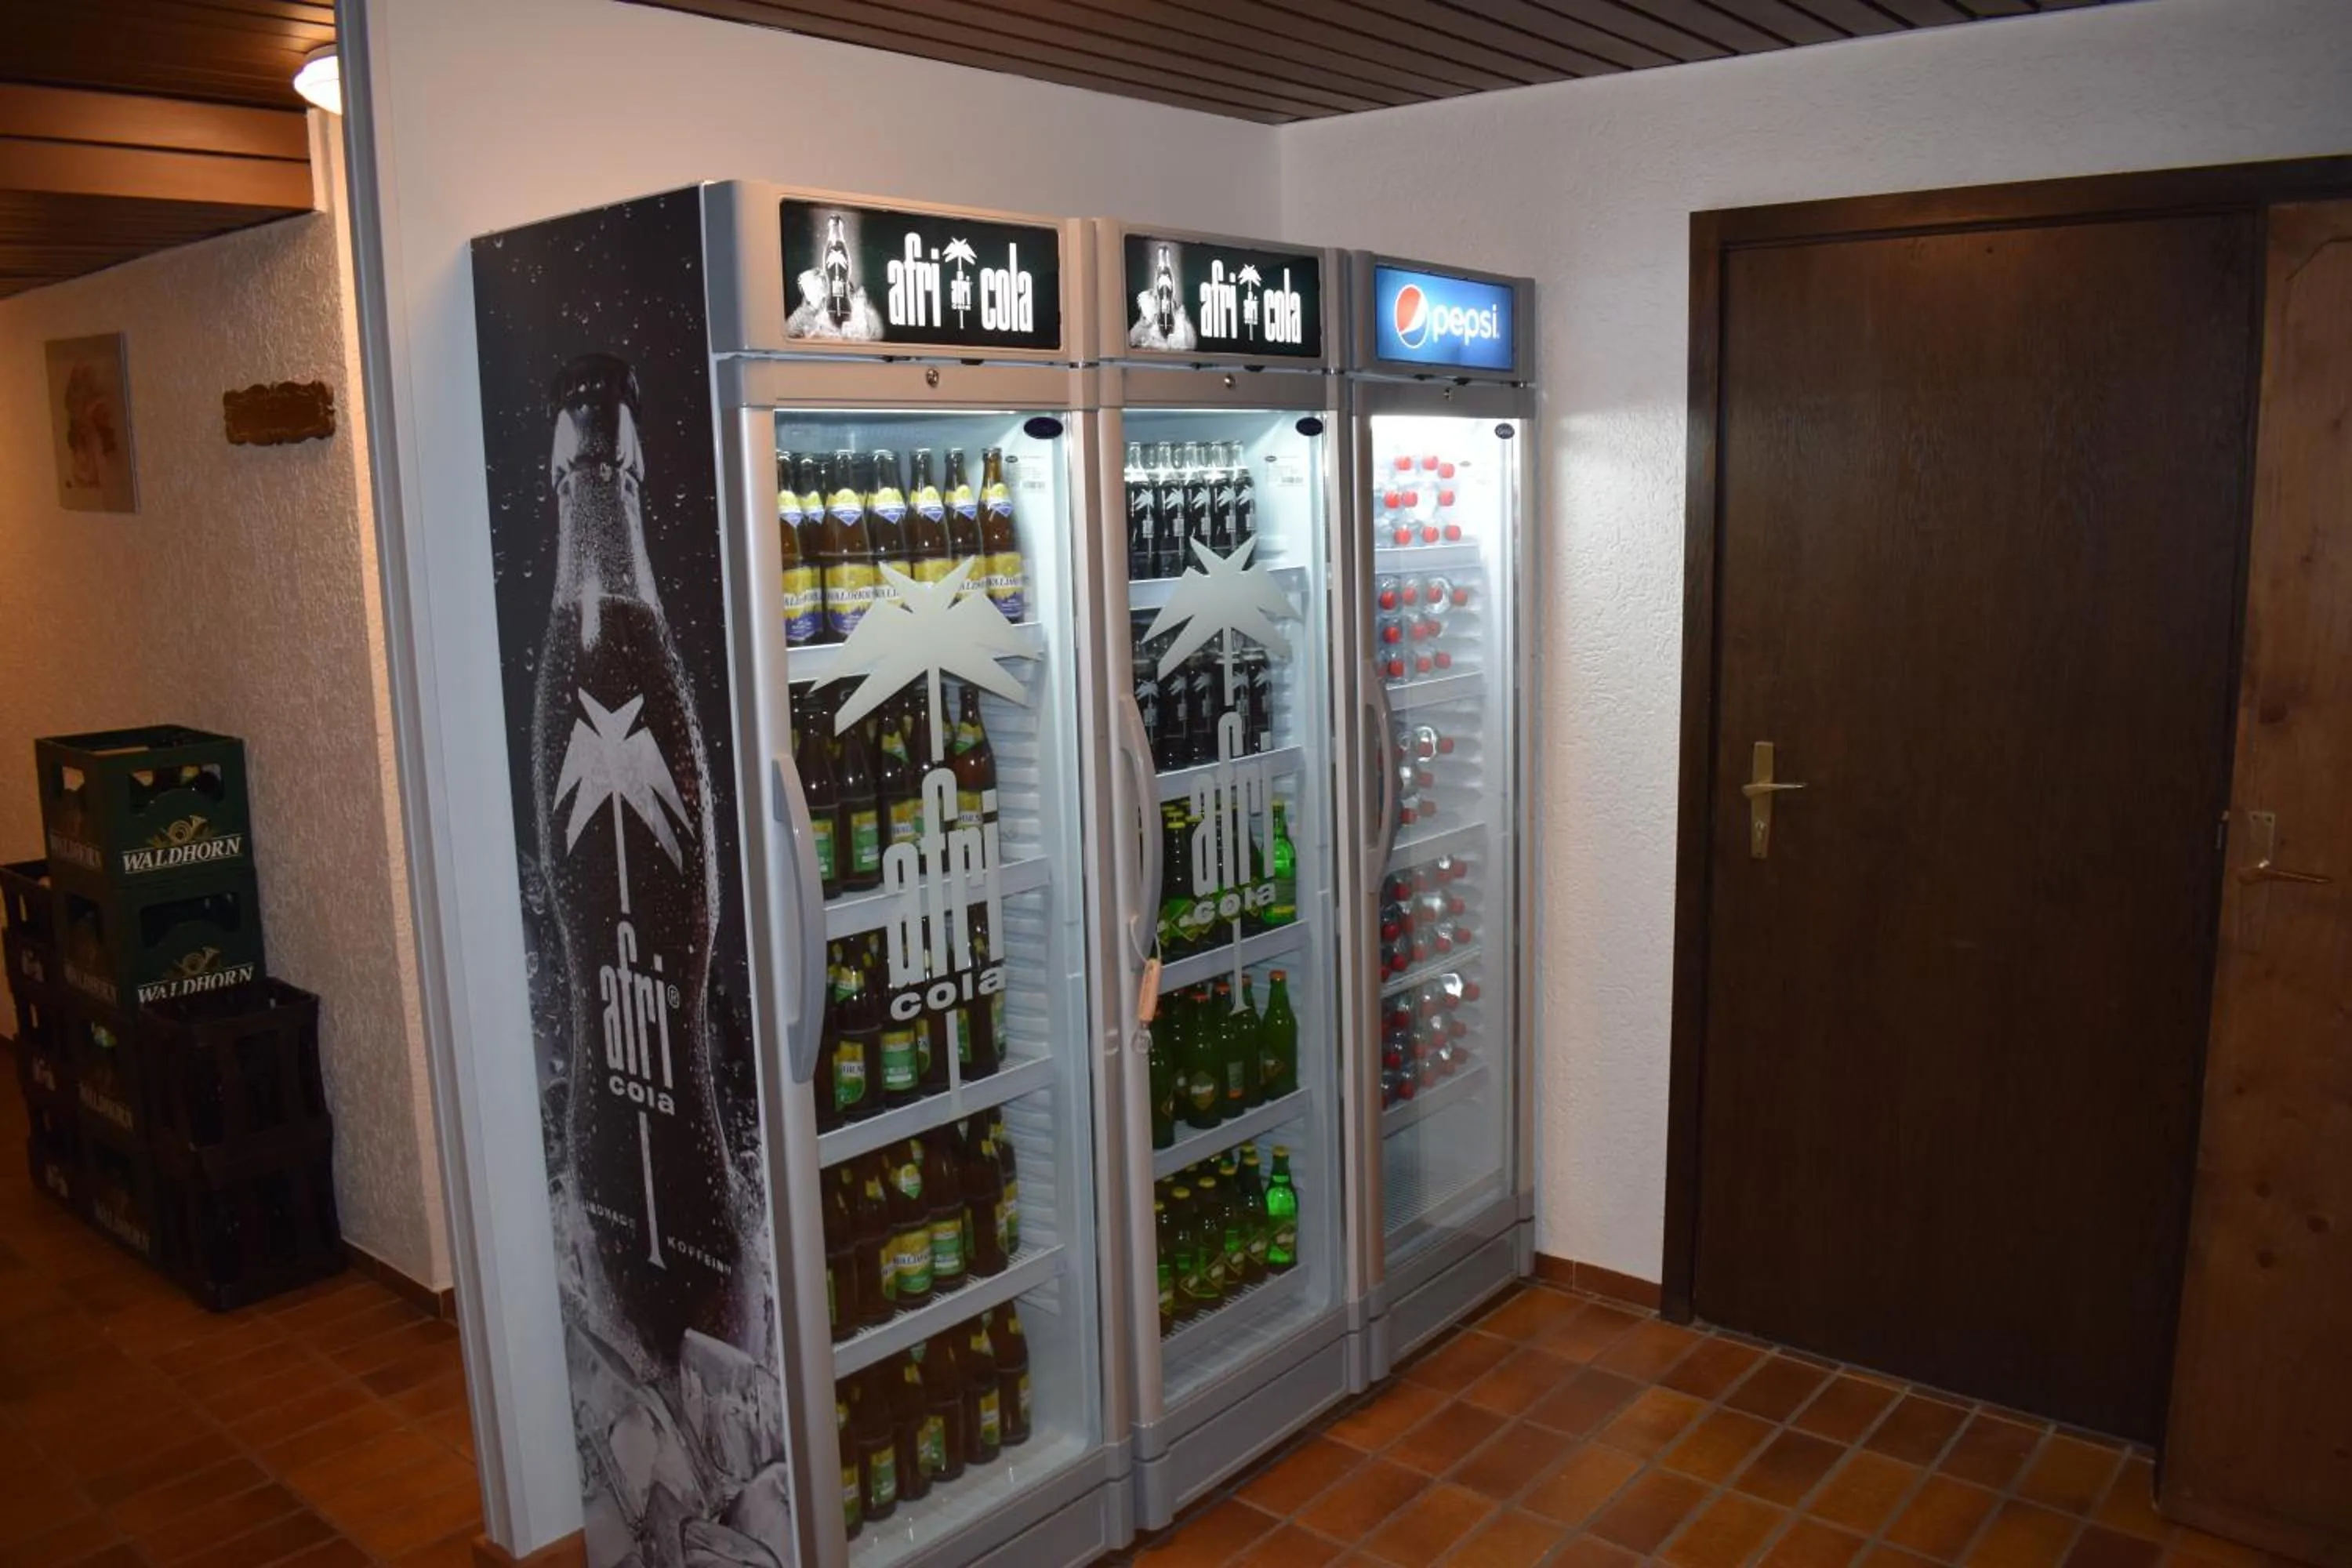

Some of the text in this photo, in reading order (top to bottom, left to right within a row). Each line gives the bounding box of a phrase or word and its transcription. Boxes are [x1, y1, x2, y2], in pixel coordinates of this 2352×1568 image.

[887, 232, 1034, 333] afri cola
[1200, 260, 1302, 345] afri cola
[1432, 304, 1497, 346] pepsi
[1189, 712, 1276, 898] afri
[123, 837, 242, 872] WALDHORN
[883, 768, 1004, 988] afri
[1194, 883, 1276, 924] cola
[137, 967, 254, 1004] WALDHORN
[599, 921, 673, 1088] afri
[890, 964, 1005, 1021] cola
[609, 1074, 675, 1116] cola
